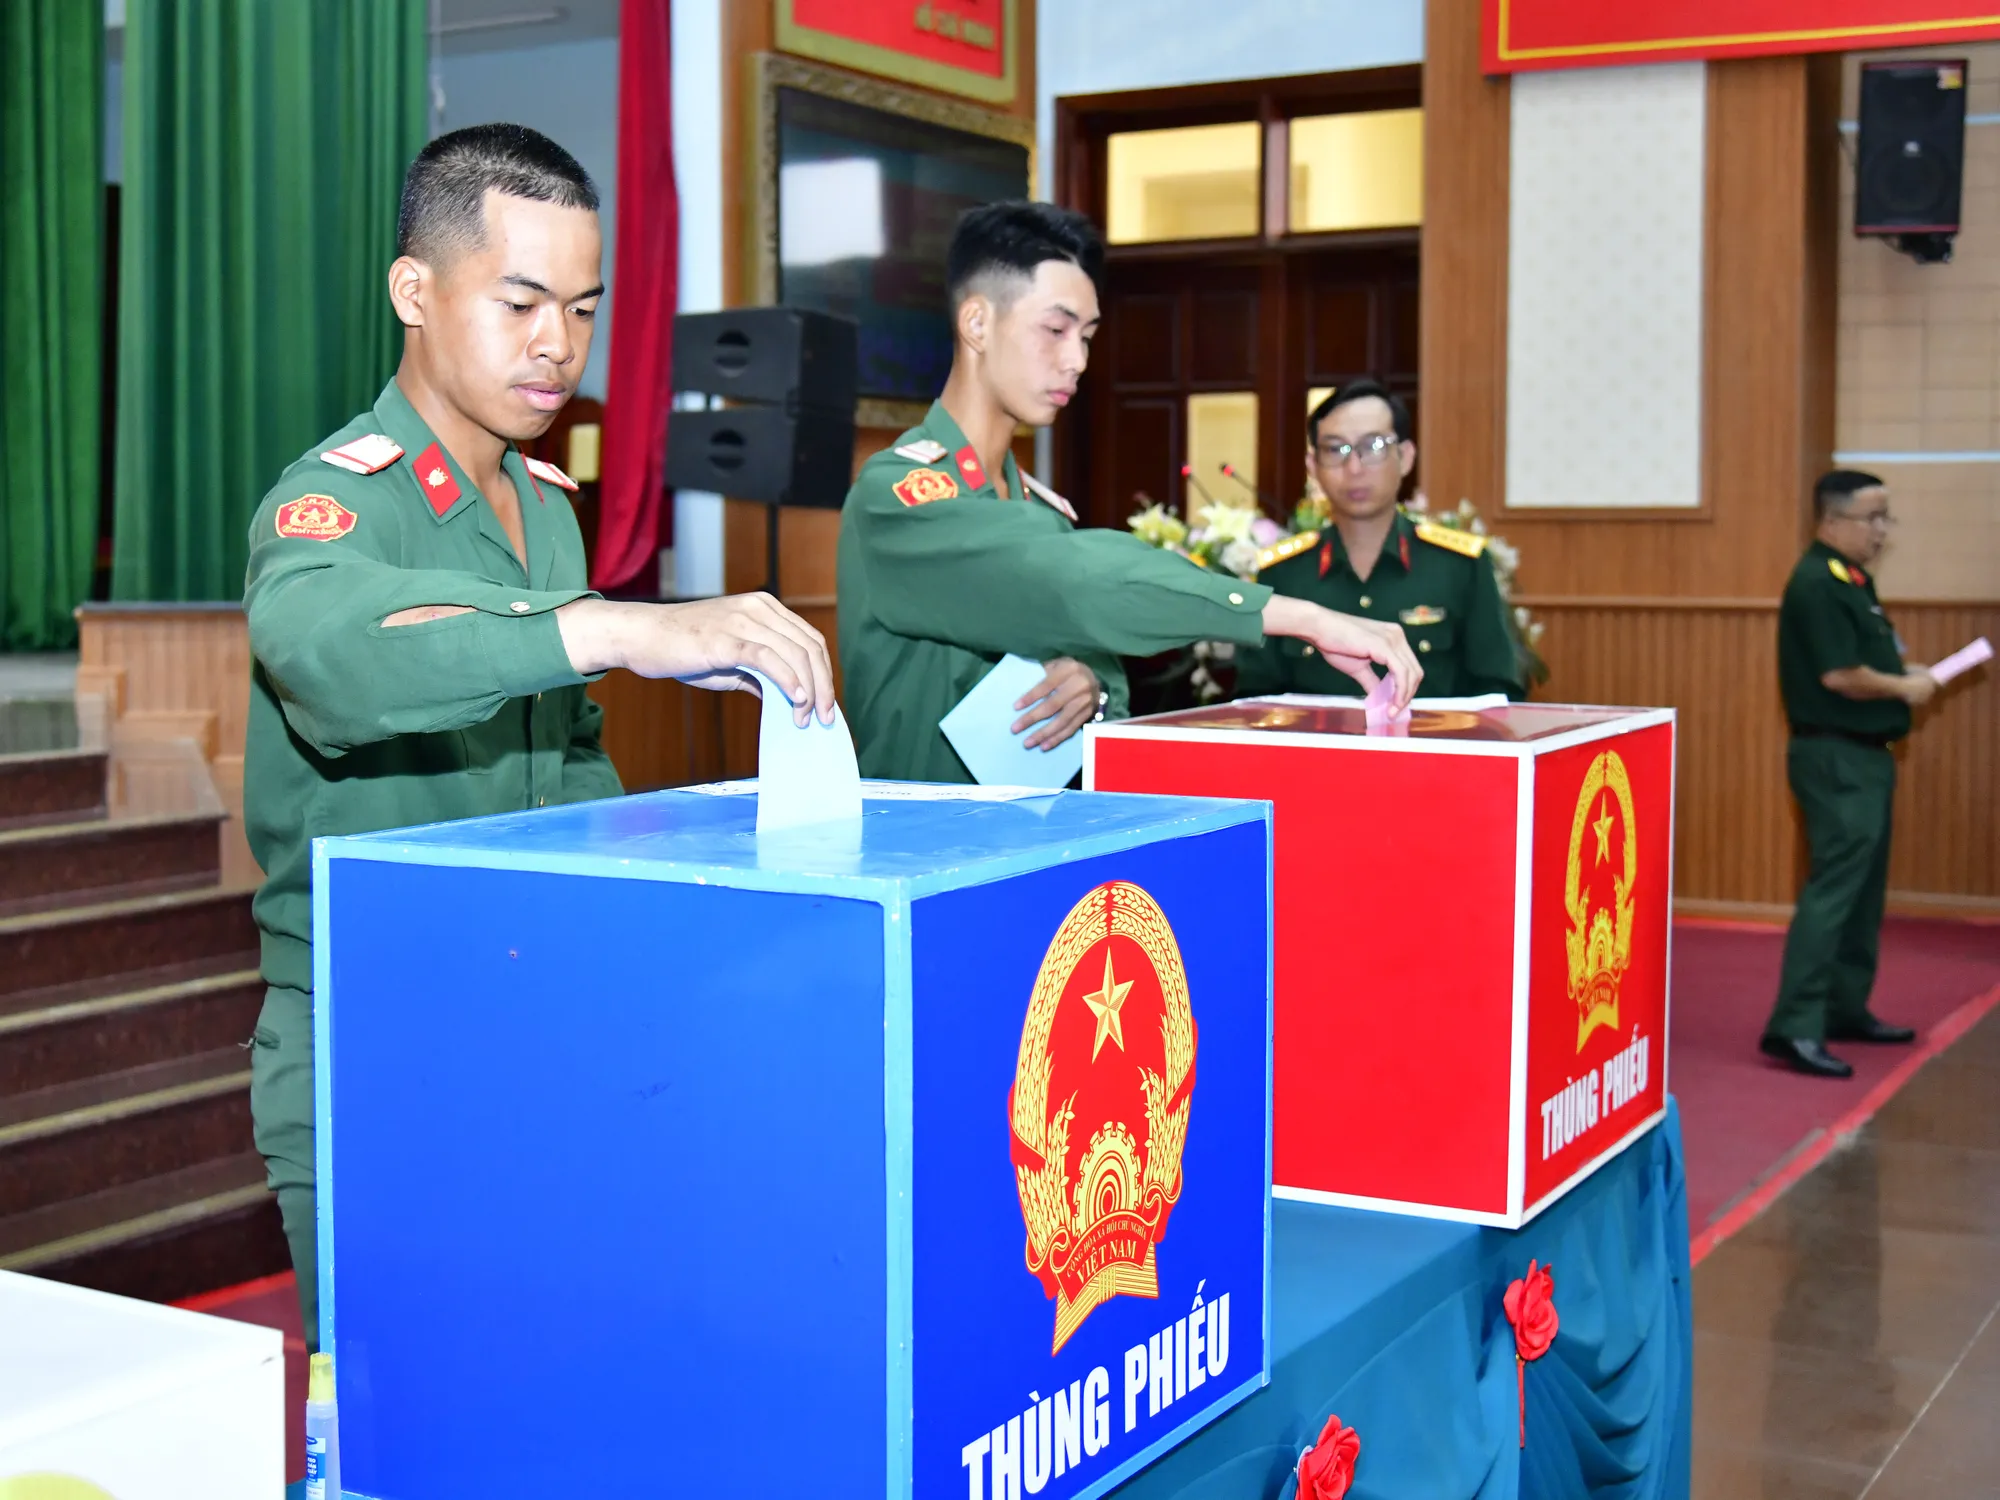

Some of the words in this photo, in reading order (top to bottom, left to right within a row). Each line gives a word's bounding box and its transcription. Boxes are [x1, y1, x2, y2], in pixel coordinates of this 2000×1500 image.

[1541, 1076, 1599, 1161] THÙNG
[1602, 1023, 1649, 1118] PHIẾU
[1077, 1243, 1107, 1284] VIỆT
[1109, 1239, 1137, 1259] NAM
[962, 1366, 1110, 1500] THÙNG
[1125, 1278, 1230, 1434] PHIẾU
